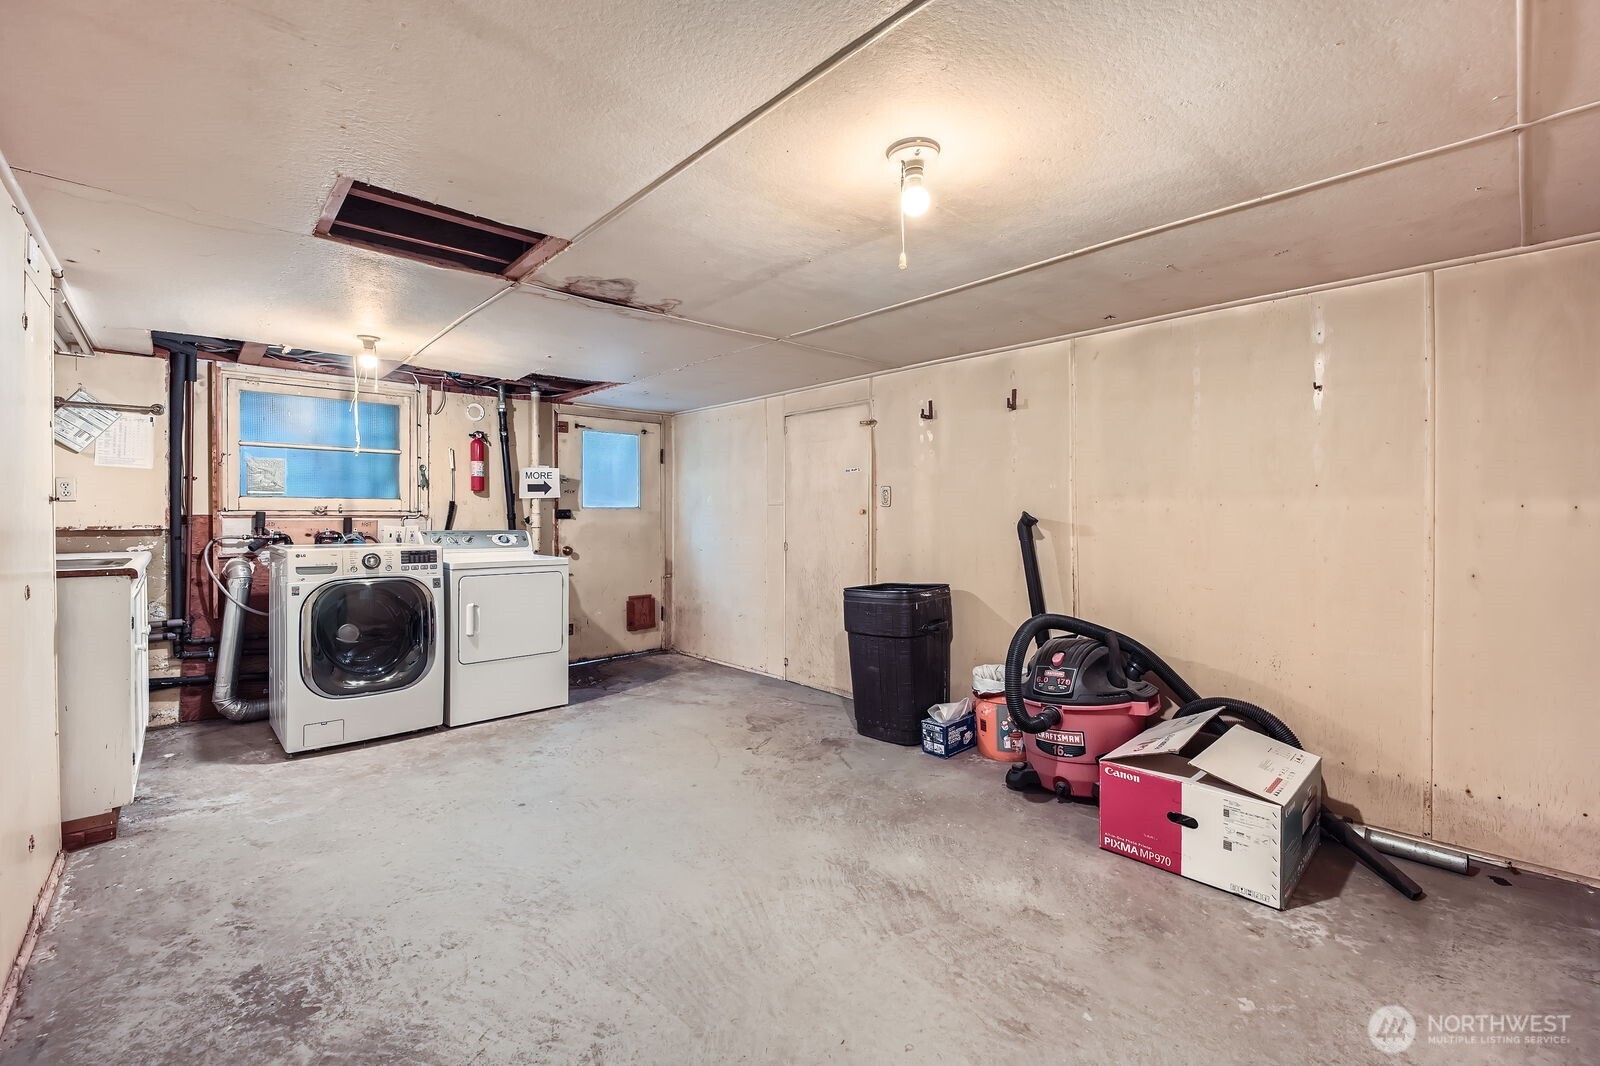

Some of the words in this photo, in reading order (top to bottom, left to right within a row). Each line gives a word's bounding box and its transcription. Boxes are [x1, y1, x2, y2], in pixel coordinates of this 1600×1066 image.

[525, 471, 553, 480] MORE
[1052, 744, 1064, 756] 16
[1104, 766, 1140, 783] Canon
[1104, 836, 1139, 856] PIXMA
[1139, 848, 1172, 867] MP970
